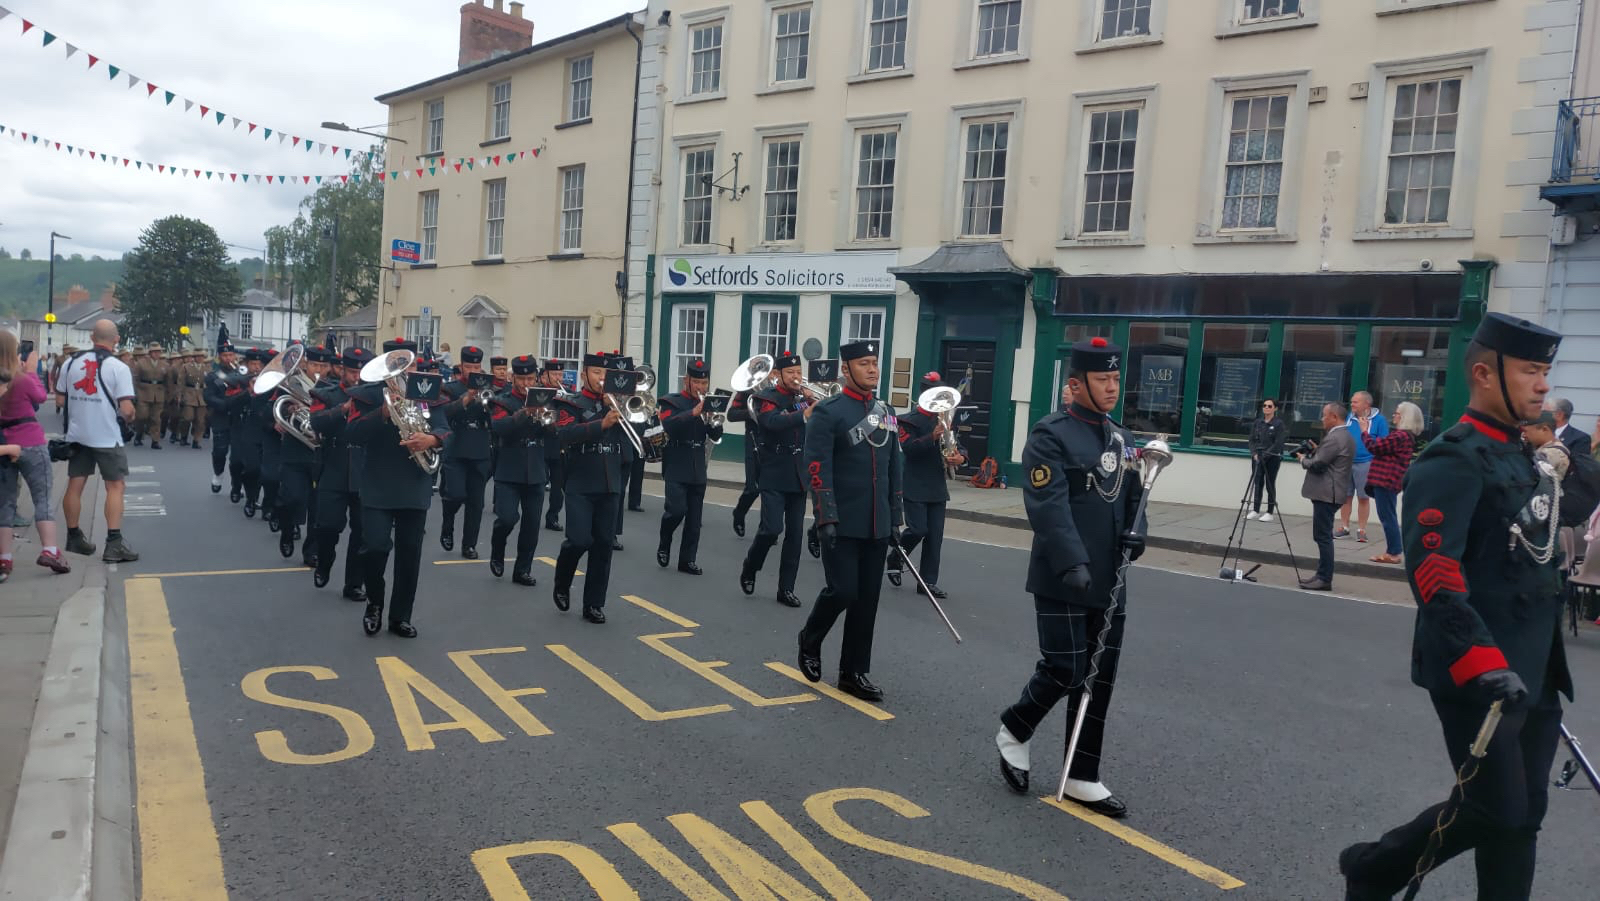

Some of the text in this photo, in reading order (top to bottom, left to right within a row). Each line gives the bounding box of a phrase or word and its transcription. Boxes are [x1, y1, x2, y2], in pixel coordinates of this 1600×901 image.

[693, 265, 845, 287] Setfords Solicitors
[1148, 368, 1173, 381] M&B
[1391, 379, 1423, 394] M&B
[240, 631, 821, 766] SAFLE
